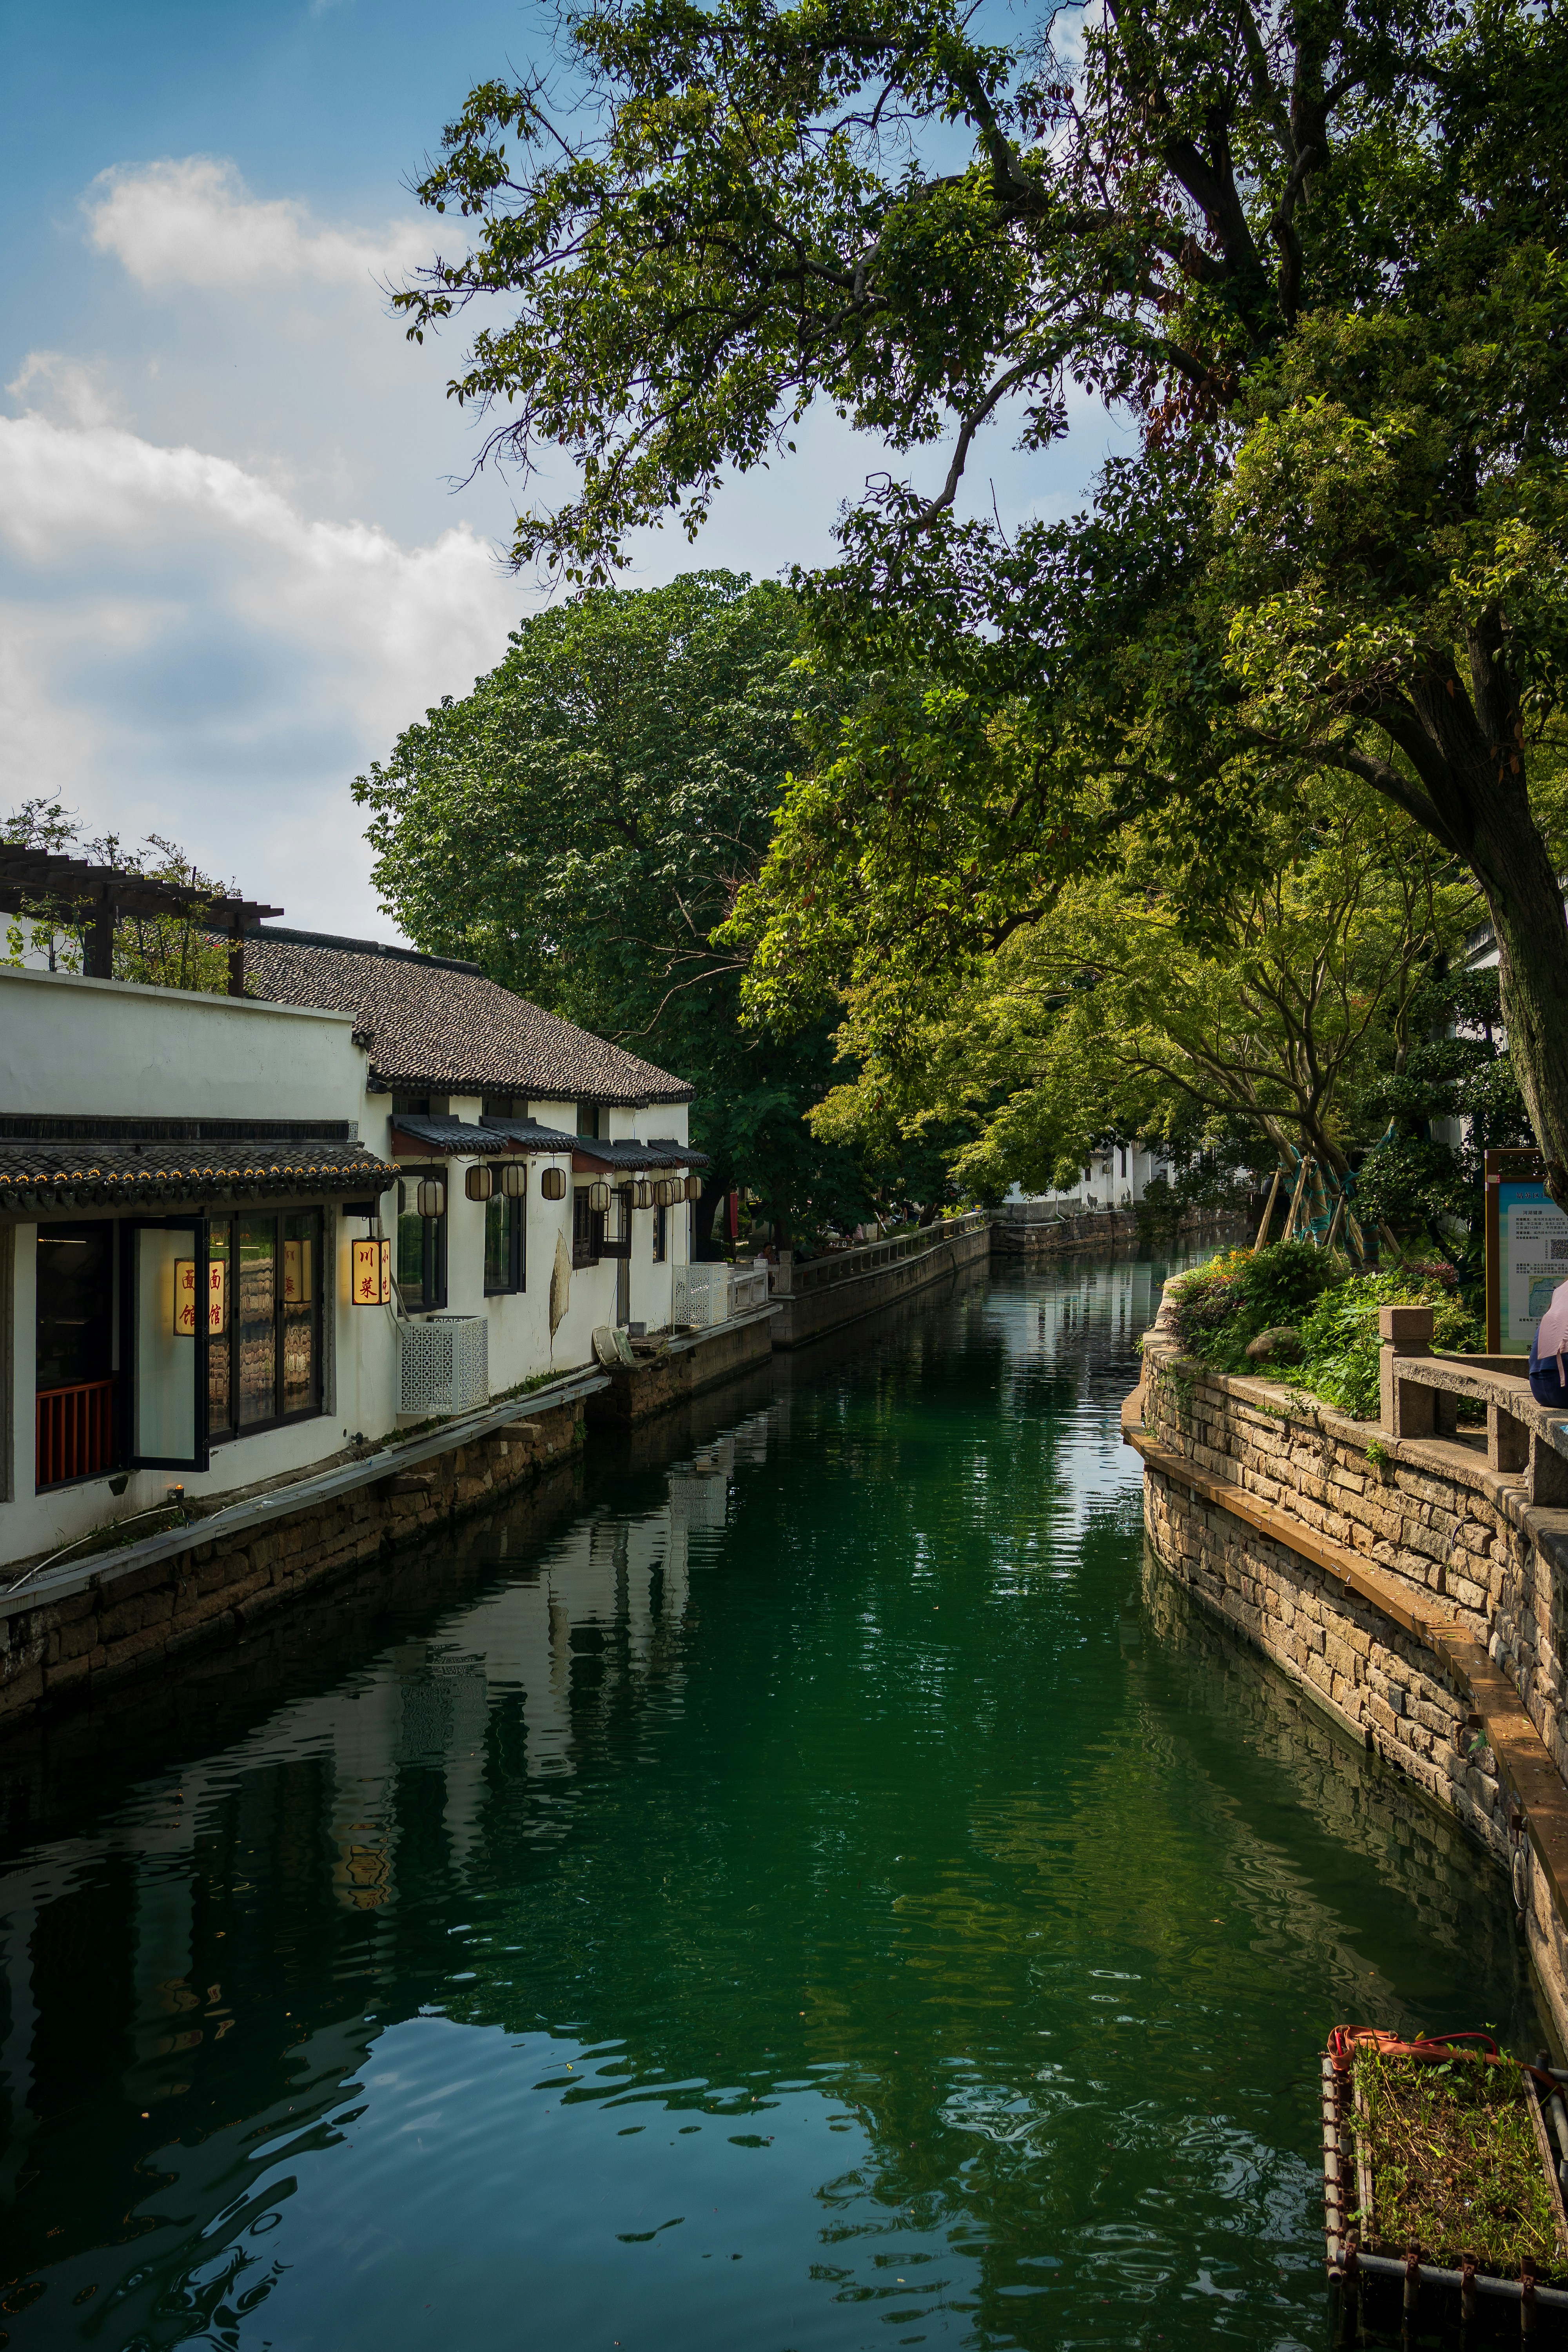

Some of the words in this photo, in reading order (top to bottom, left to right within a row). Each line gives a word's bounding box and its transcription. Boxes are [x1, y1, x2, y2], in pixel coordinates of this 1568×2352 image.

[209, 1269, 221, 1326] 面馆
[359, 1247, 377, 1298] 川菜
[382, 1249, 389, 1295] 小吃
